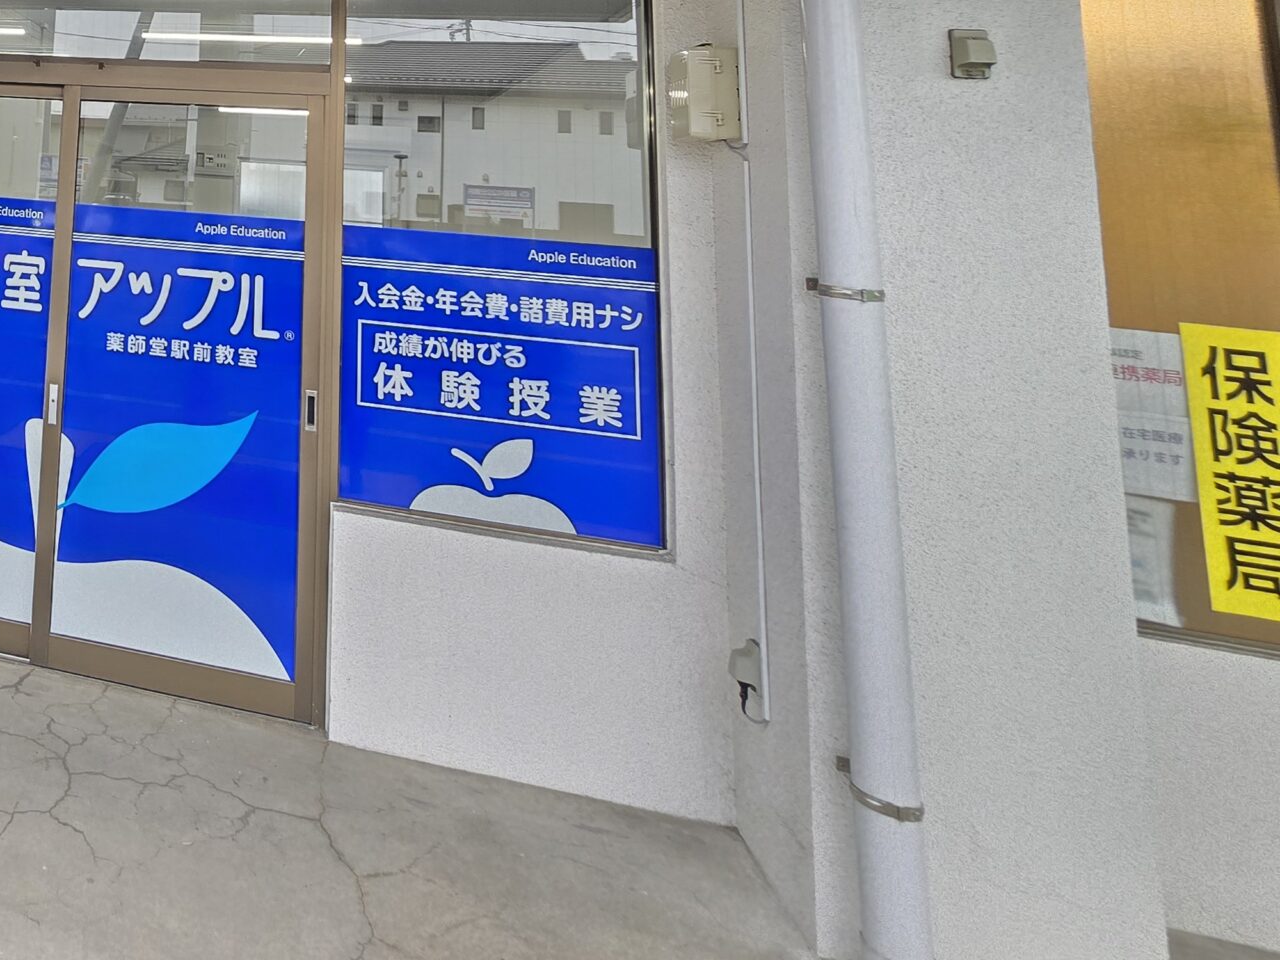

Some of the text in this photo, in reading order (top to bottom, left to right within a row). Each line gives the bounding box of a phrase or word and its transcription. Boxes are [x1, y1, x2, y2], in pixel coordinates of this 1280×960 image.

[195, 222, 286, 240] Apple Education
[528, 249, 637, 269] Apple Education
[353, 281, 643, 331] 入会金・年会費・諸費用ナシ
[106, 331, 258, 368] 薬師堂駅前教室
[373, 330, 527, 368] 成績が伸びる
[373, 362, 623, 428] 体験授業
[1201, 345, 1280, 600] 保険薬局
